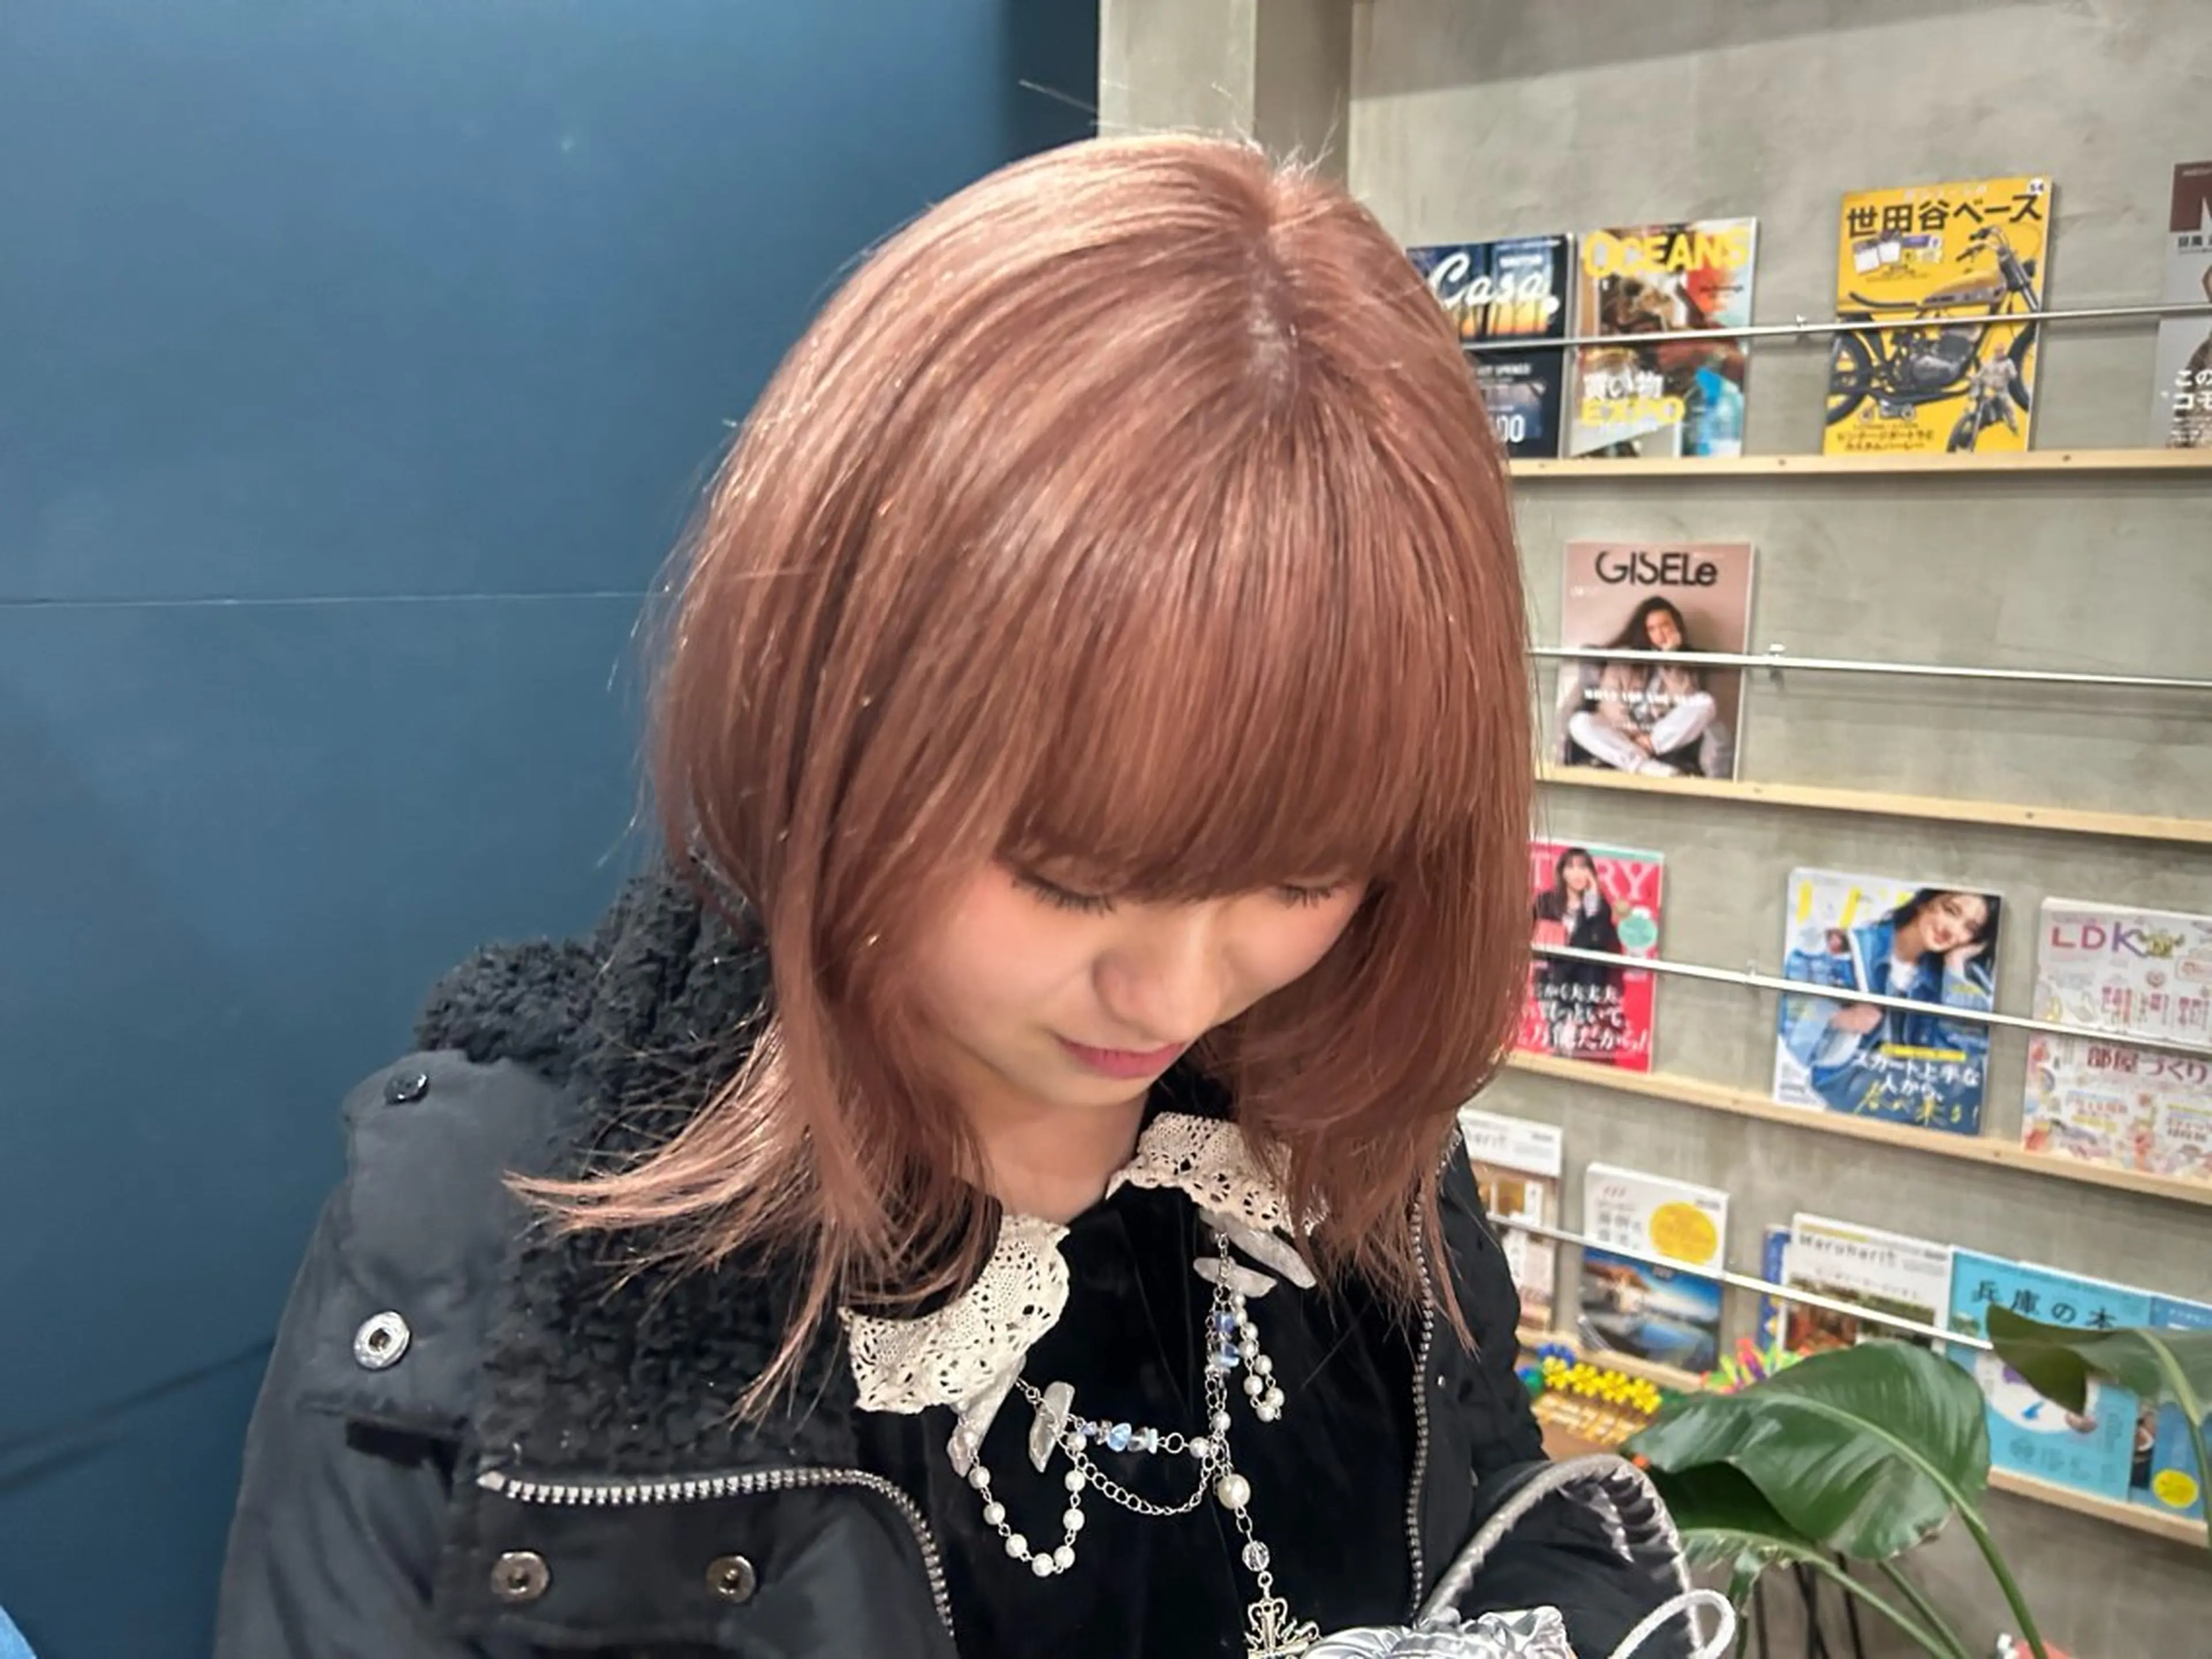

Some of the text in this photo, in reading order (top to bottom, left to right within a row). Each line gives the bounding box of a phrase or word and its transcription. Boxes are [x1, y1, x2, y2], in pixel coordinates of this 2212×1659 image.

[1847, 194, 2043, 238] 世田谷ベース
[1582, 226, 1749, 278] OCEANS
[1428, 252, 1559, 315] Casa
[1594, 550, 1718, 587] GISELe
[2051, 921, 2149, 959] LDK
